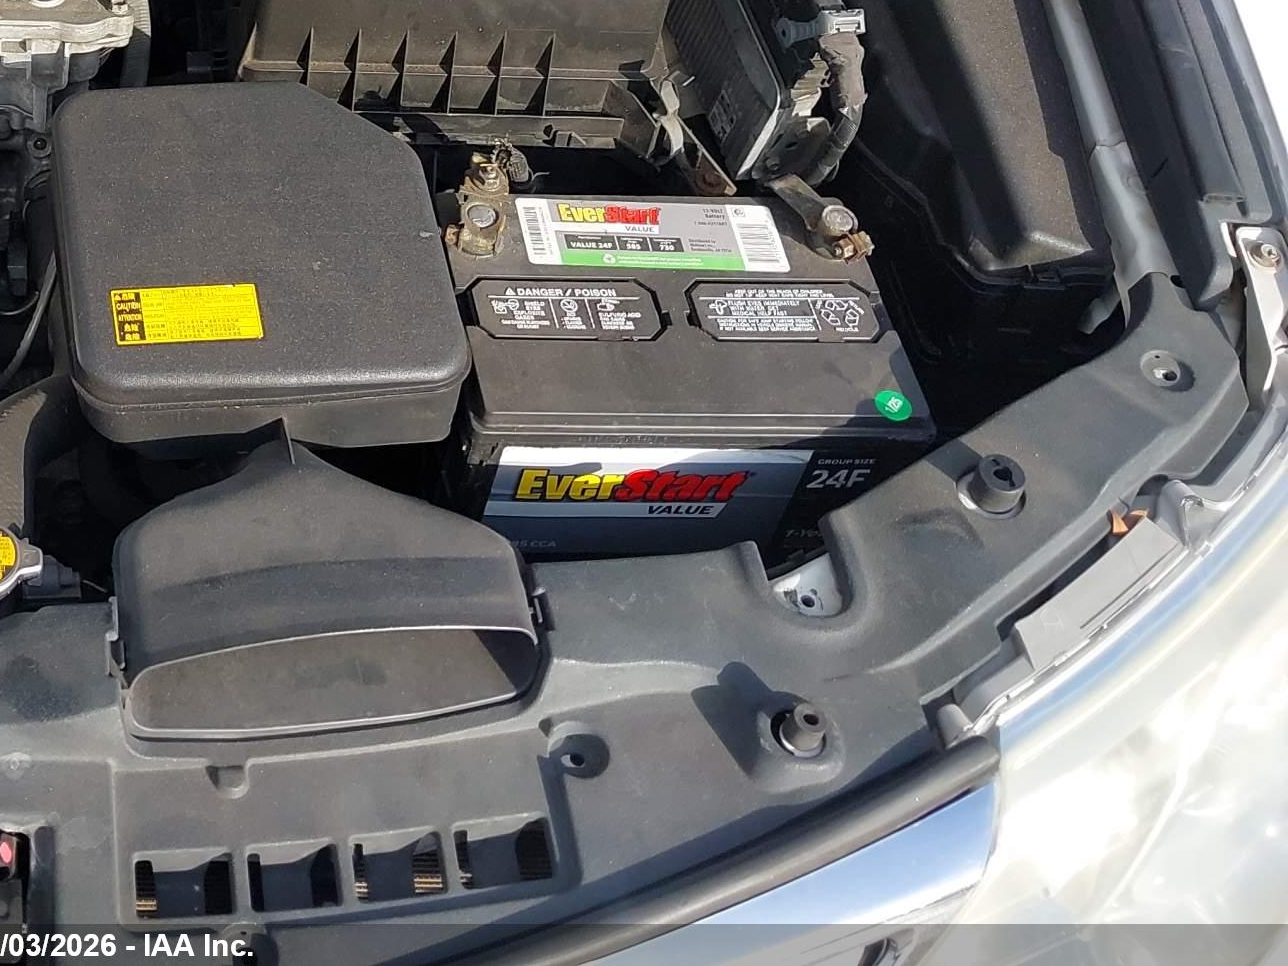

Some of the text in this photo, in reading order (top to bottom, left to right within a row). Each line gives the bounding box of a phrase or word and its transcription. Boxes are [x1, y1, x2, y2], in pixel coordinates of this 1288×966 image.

[558, 203, 660, 225] EverStart
[624, 225, 655, 233] VALUE
[570, 241, 597, 249] VALUE
[516, 288, 563, 296] DANGER
[574, 288, 617, 297] POISON
[116, 302, 141, 311] CAUTION
[806, 469, 871, 489] 24F
[515, 468, 748, 501] EverStart
[646, 505, 715, 515] VALUE
